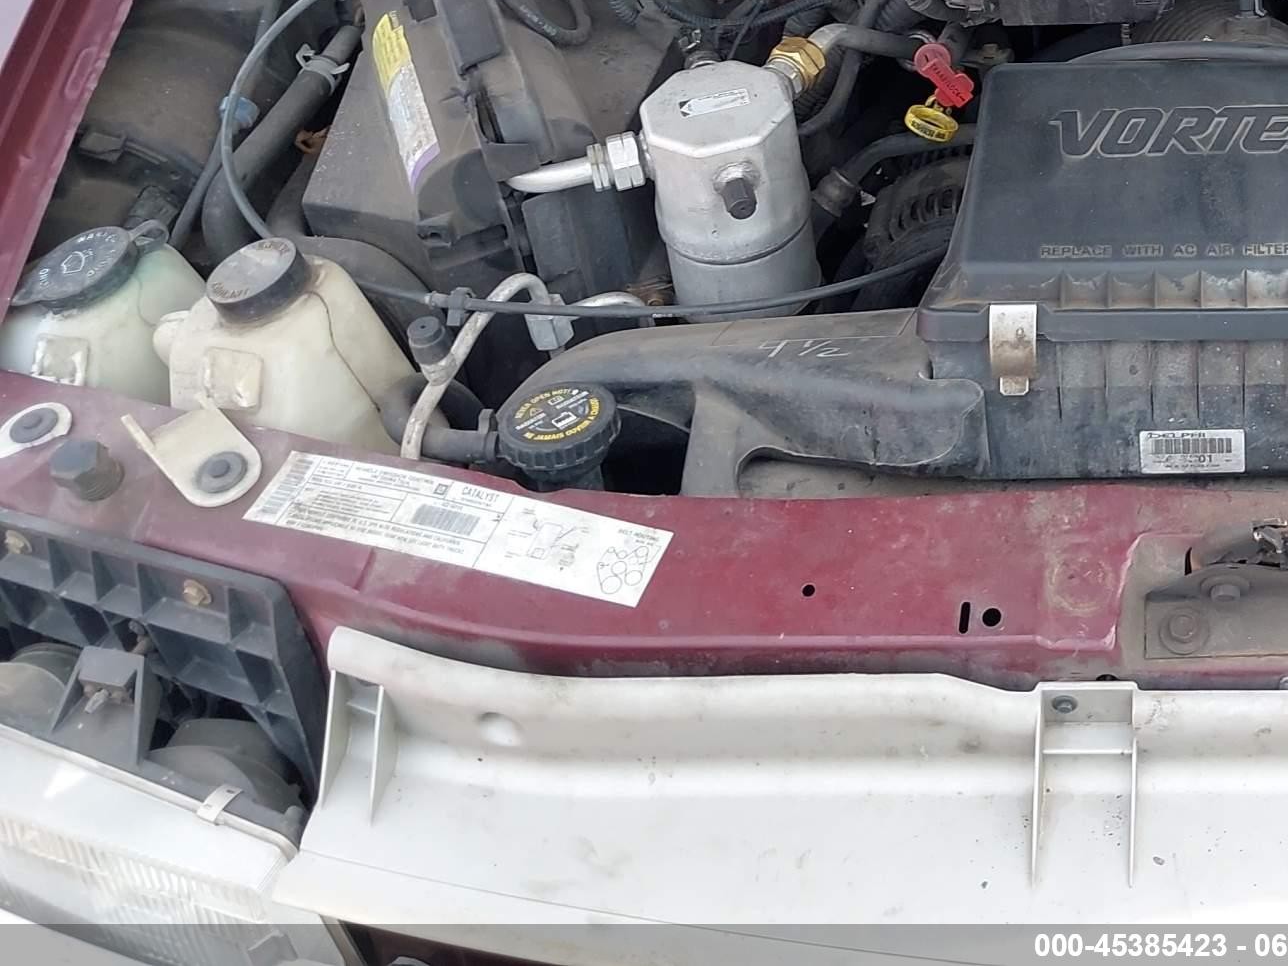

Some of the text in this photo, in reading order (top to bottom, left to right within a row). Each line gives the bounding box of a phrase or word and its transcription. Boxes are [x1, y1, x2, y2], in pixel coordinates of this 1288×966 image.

[1040, 244, 1112, 258] REPLACE
[1122, 244, 1163, 257] WITH
[1173, 244, 1198, 256] AC
[1206, 243, 1234, 256] AIR
[459, 487, 500, 503] CATALYST
